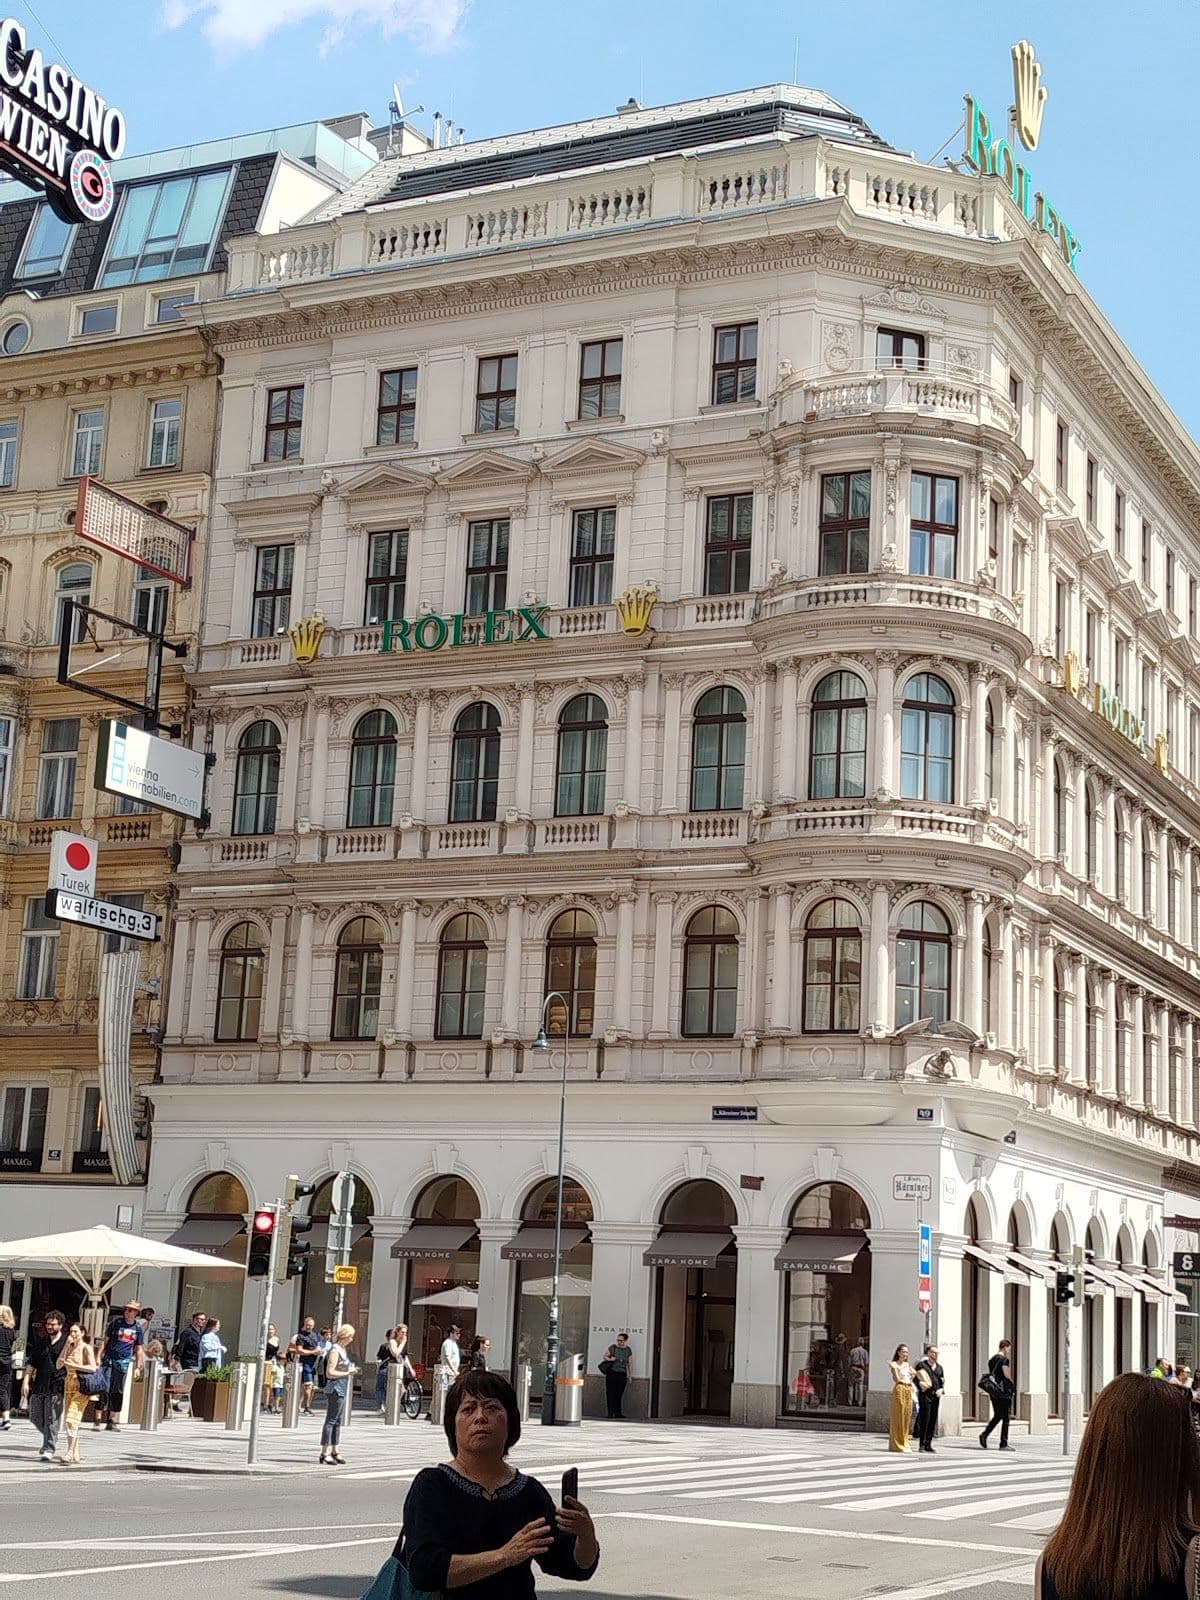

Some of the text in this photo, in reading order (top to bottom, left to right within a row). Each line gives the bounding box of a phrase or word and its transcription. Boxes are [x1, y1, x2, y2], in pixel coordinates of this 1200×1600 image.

[0, 18, 126, 160] CASINO
[0, 95, 69, 178] WIEN
[380, 605, 550, 654] ROLEX
[127, 763, 159, 781] vienna
[126, 774, 199, 810] immobilien.com
[60, 873, 91, 894] Turek
[397, 1250, 422, 1258] ZARA
[508, 1251, 534, 1259] ZARA
[650, 1257, 677, 1265] ZARA
[813, 1263, 843, 1272] HOME
[618, 1327, 645, 1335] HOME
